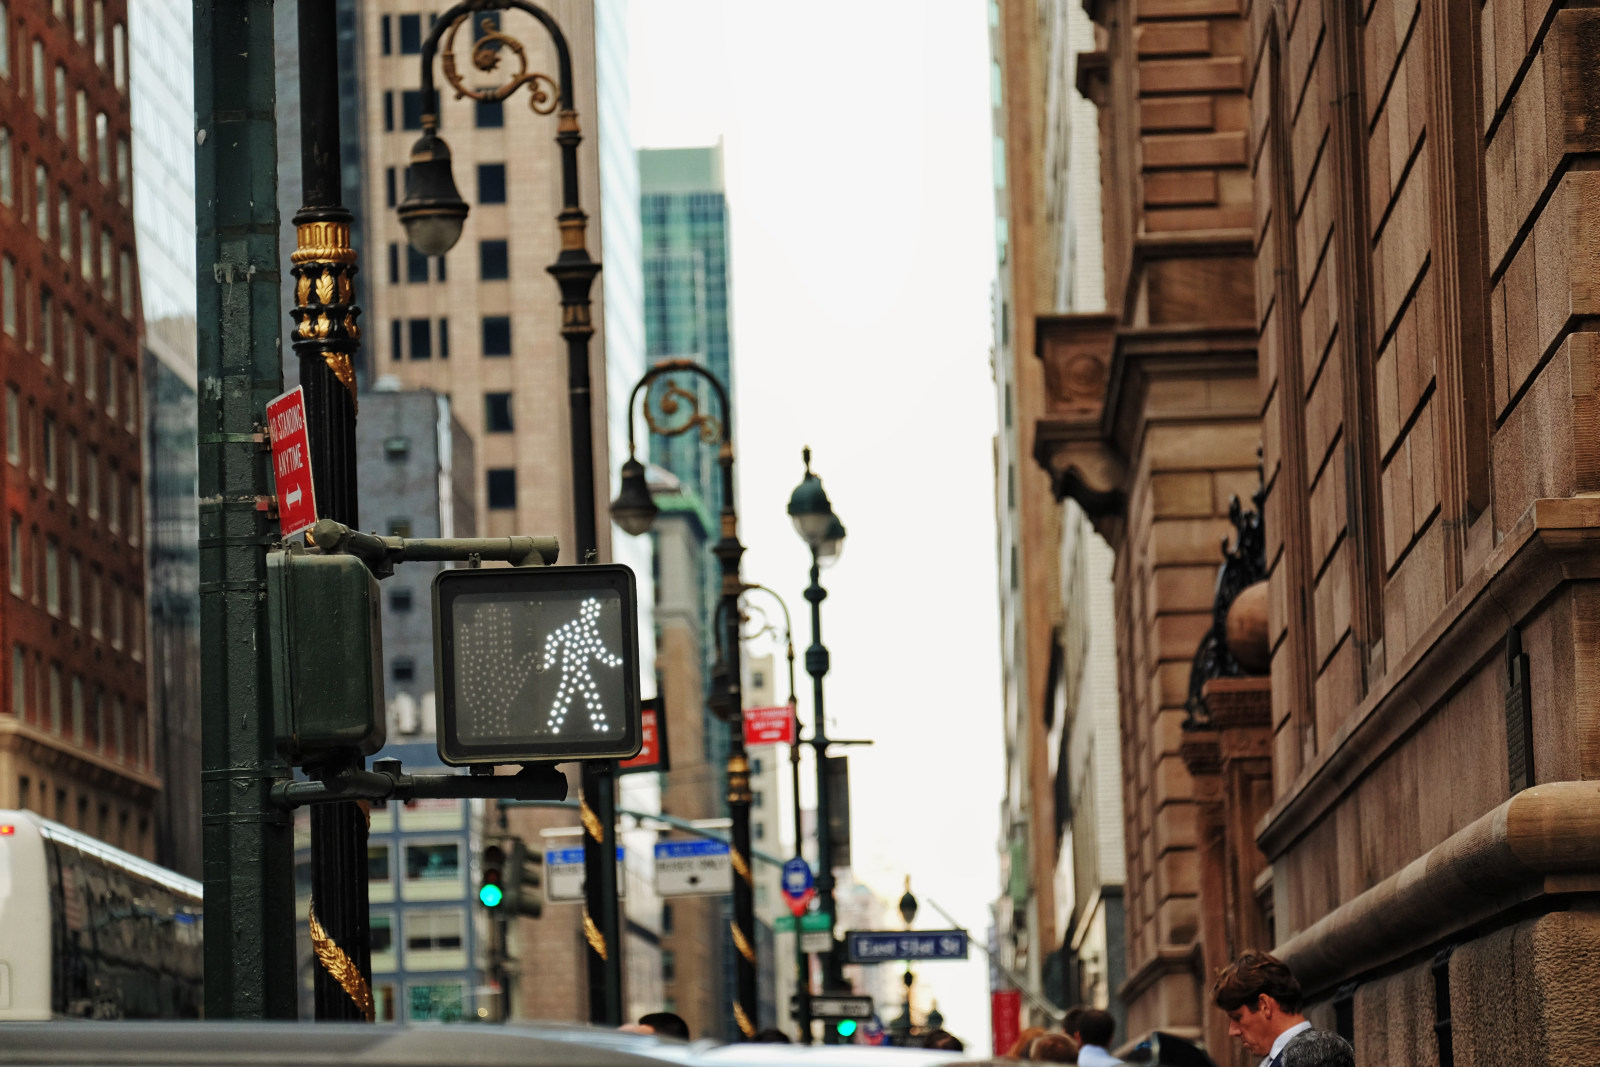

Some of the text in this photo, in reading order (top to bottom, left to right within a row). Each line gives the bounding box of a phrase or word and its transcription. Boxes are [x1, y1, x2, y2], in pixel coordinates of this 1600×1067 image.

[270, 404, 303, 443] NO STANDING
[278, 443, 303, 478] ANYTIME
[858, 939, 897, 957] East
[940, 936, 960, 956] St
